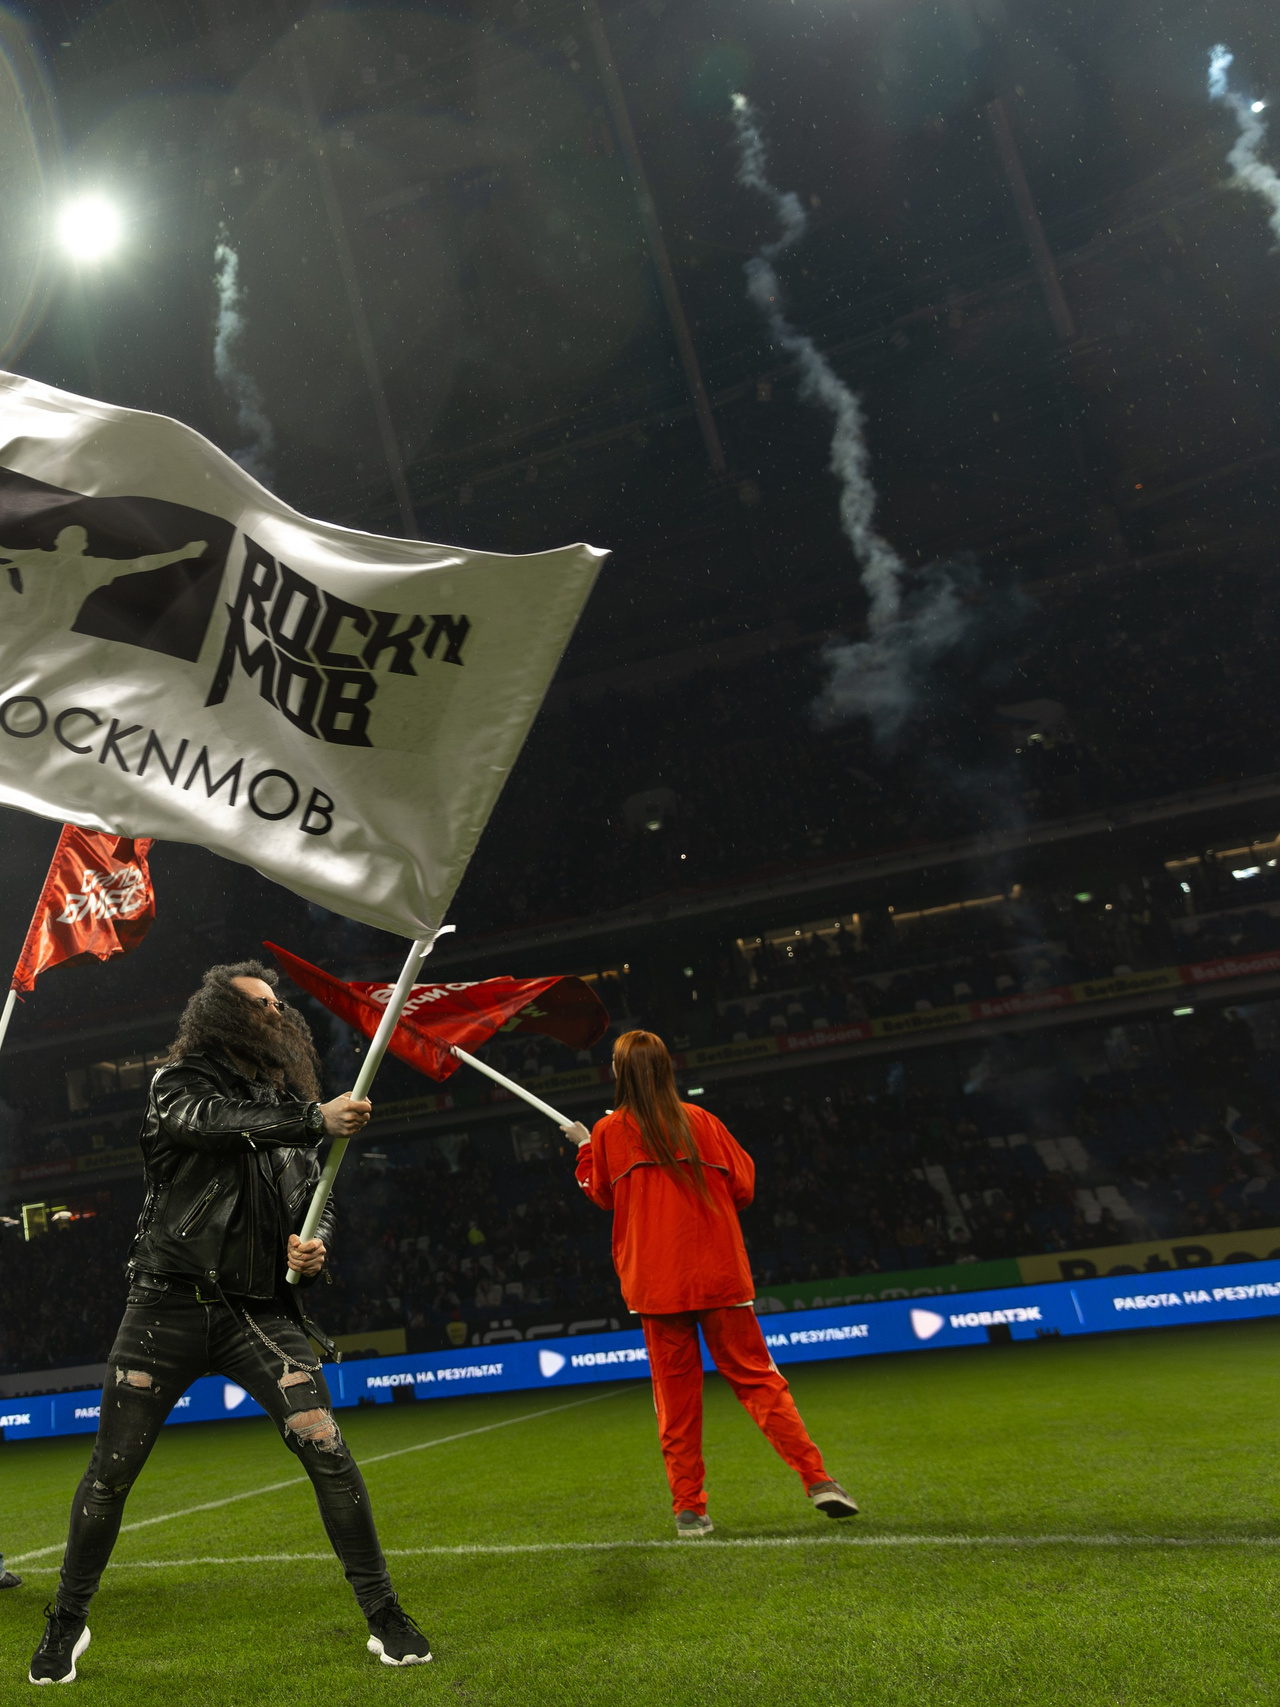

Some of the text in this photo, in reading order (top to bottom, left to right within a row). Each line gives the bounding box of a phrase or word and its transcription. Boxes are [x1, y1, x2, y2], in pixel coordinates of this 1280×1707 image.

[204, 602, 377, 748] MOB
[1112, 1292, 1183, 1311] РАБОТА
[1182, 1289, 1212, 1304] НА
[948, 1306, 1043, 1328] НОВАТЭК
[764, 1324, 869, 1347] НА РЕЗУЛЬТАТ
[570, 1347, 649, 1368] НОВАТЭК
[366, 1363, 504, 1388] РАБОТА НА РЕЗУЛЬТАТ
